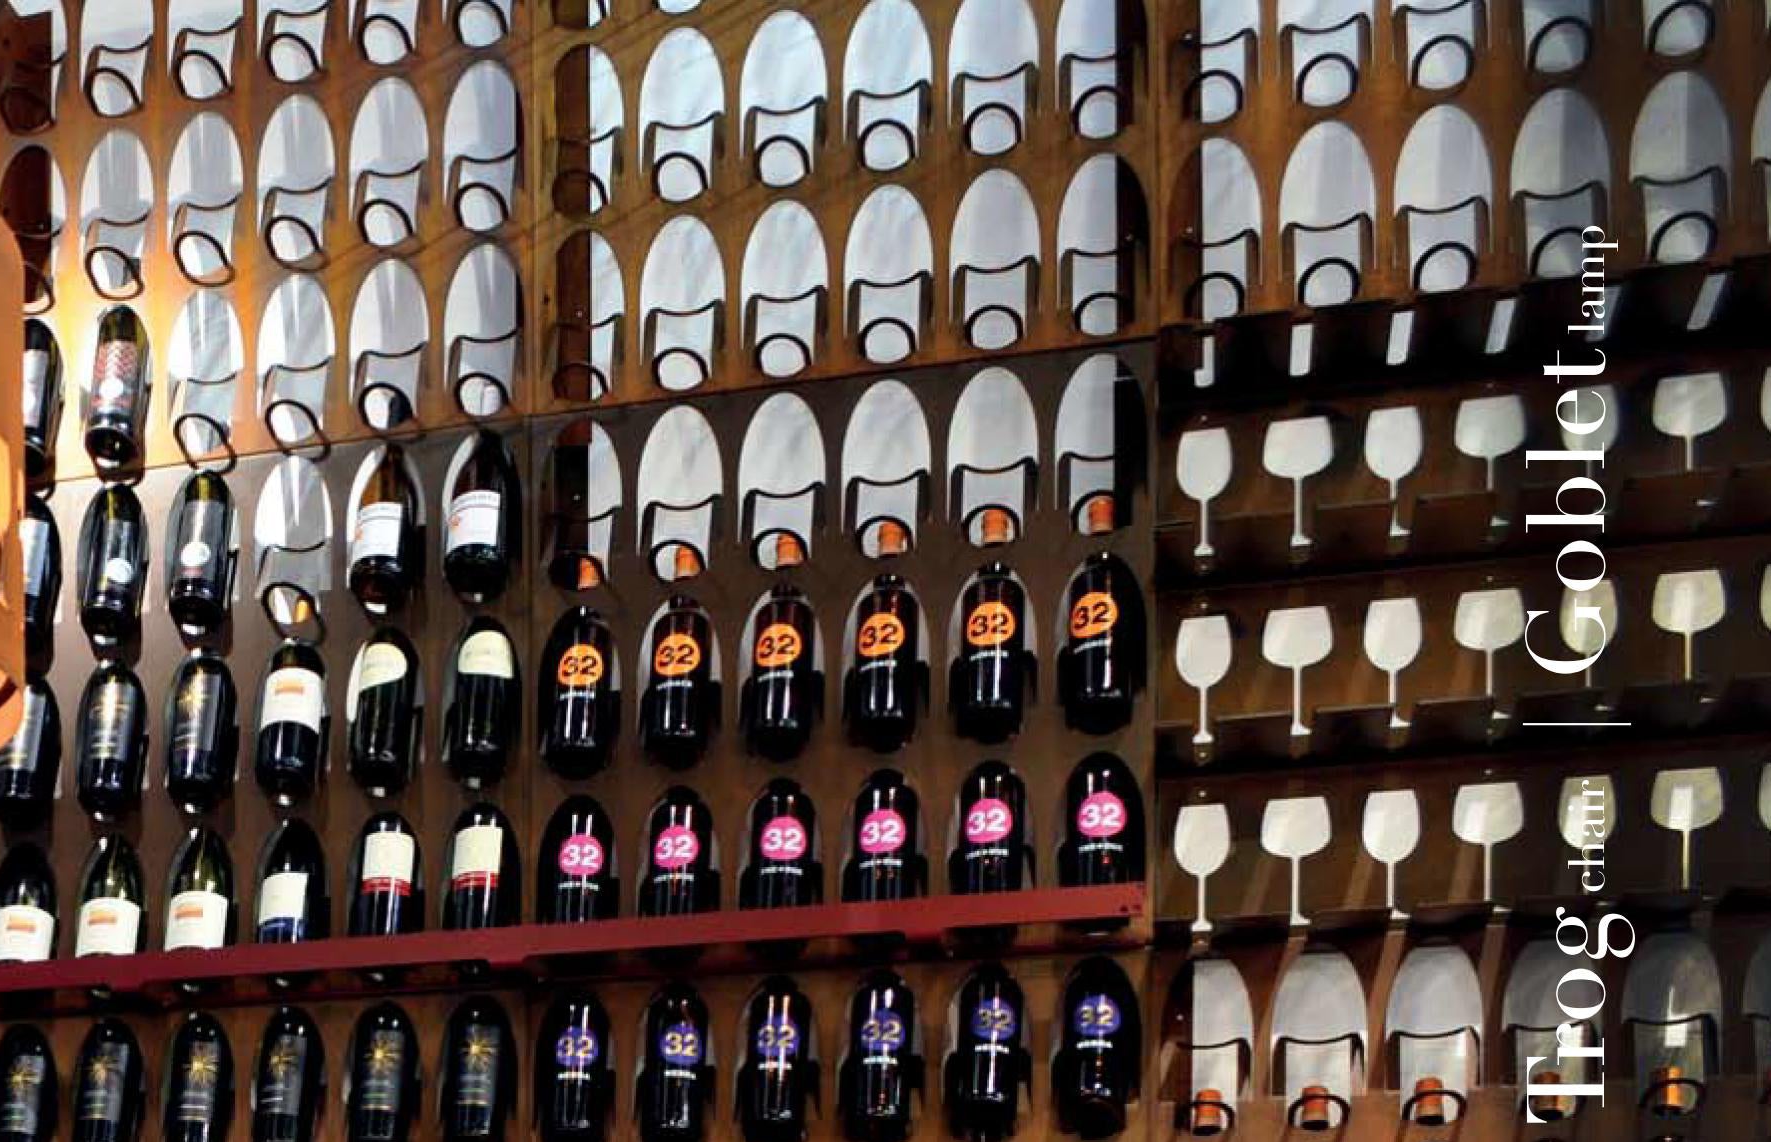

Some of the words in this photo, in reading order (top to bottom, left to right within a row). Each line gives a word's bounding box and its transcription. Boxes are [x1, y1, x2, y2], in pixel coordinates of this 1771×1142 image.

[971, 614, 1009, 637] 32
[1073, 601, 1109, 630] 32
[759, 633, 795, 659] 32
[860, 621, 897, 648] 32
[658, 640, 694, 666] 32
[562, 655, 598, 678] 32
[969, 807, 1007, 835] 32
[1082, 803, 1121, 828] 32
[764, 827, 802, 853] 32
[863, 818, 901, 845] 32
[562, 843, 600, 868] 32
[657, 834, 694, 860] 32
